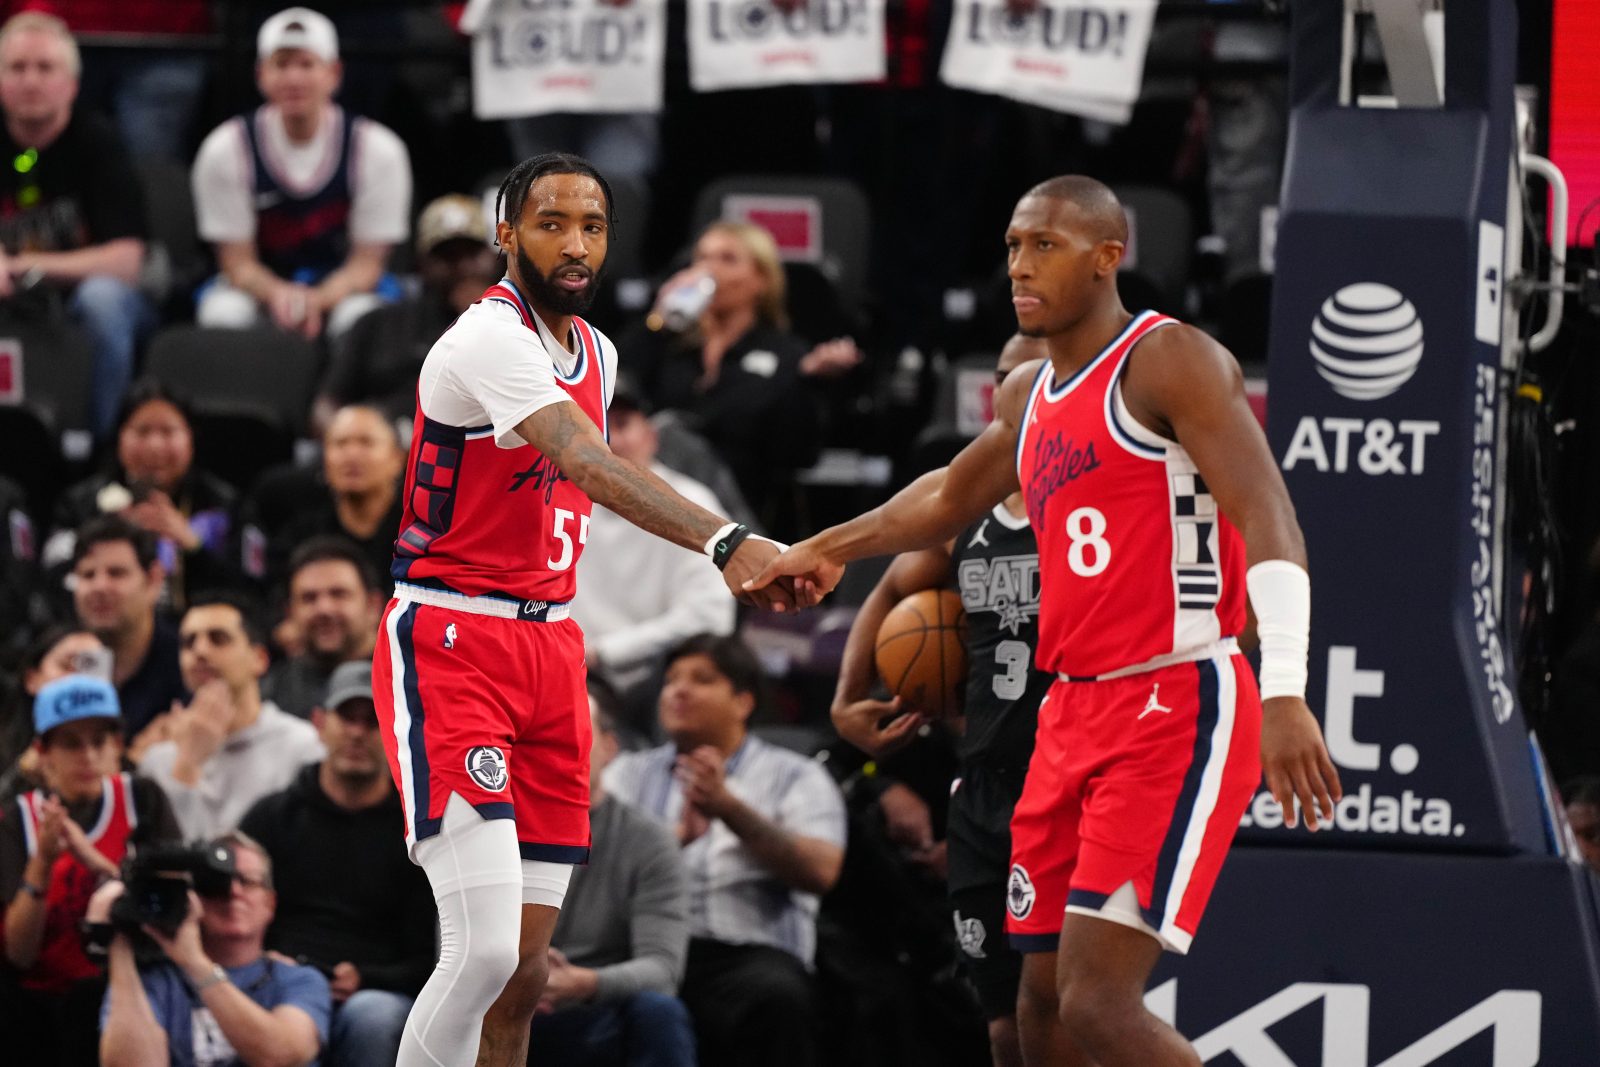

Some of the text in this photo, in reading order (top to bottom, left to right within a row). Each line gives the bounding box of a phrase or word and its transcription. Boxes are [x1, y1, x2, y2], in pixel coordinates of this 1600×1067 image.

[967, 1, 1127, 57] LOUD!
[1033, 430, 1065, 480] Los
[1282, 416, 1440, 475] AT&T
[1066, 507, 1111, 577] 8
[524, 599, 547, 615] Clips
[958, 554, 1042, 613] SAT
[992, 640, 1030, 700] 3
[1239, 783, 1465, 837] edata.
